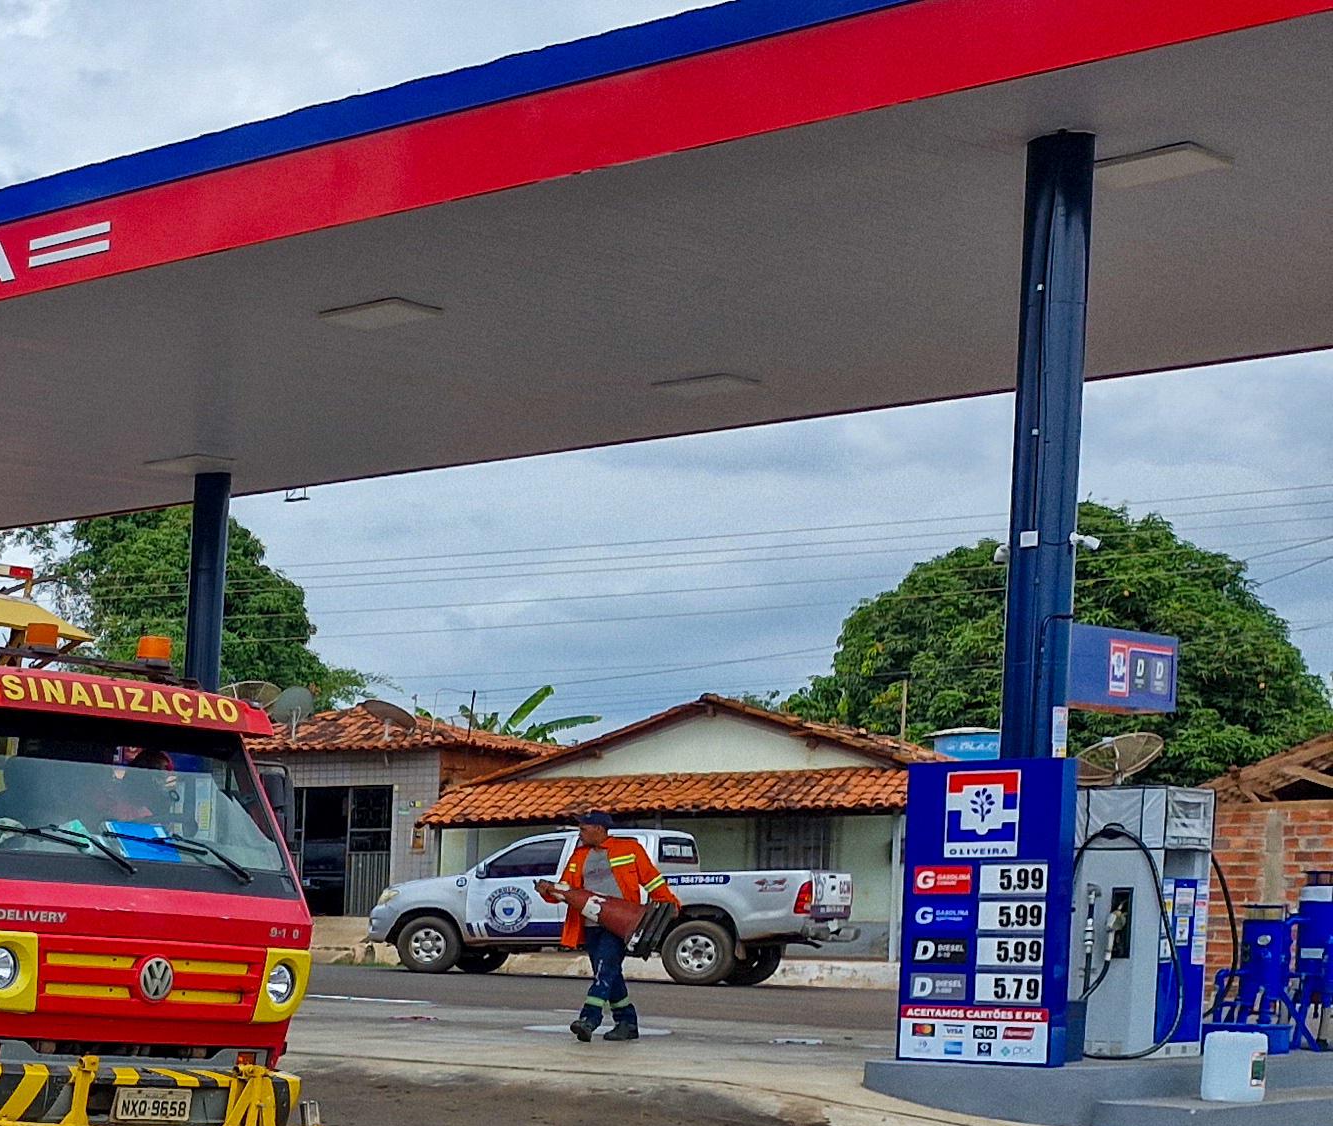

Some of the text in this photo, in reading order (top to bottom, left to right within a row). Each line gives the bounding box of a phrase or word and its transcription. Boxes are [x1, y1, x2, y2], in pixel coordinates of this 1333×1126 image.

[1136, 658, 1145, 677] D
[1155, 661, 1165, 680] D
[949, 847, 1009, 856] OLIVEIRA
[916, 870, 936, 890] G
[937, 872, 972, 880] GASOLINA
[999, 867, 1044, 891] 5,99
[915, 906, 934, 925] G
[998, 904, 1043, 928] 5,99
[913, 940, 936, 961] D
[937, 943, 965, 953] DIESEL
[996, 940, 1042, 964] 5,99
[912, 977, 934, 998] D
[934, 980, 963, 988] DIESEL
[993, 976, 1040, 1001] 5,79
[906, 1008, 1043, 1021] ACEITAMOS CARTÕES E PIX
[946, 1027, 964, 1035] VISA
[975, 1028, 996, 1038] elo
